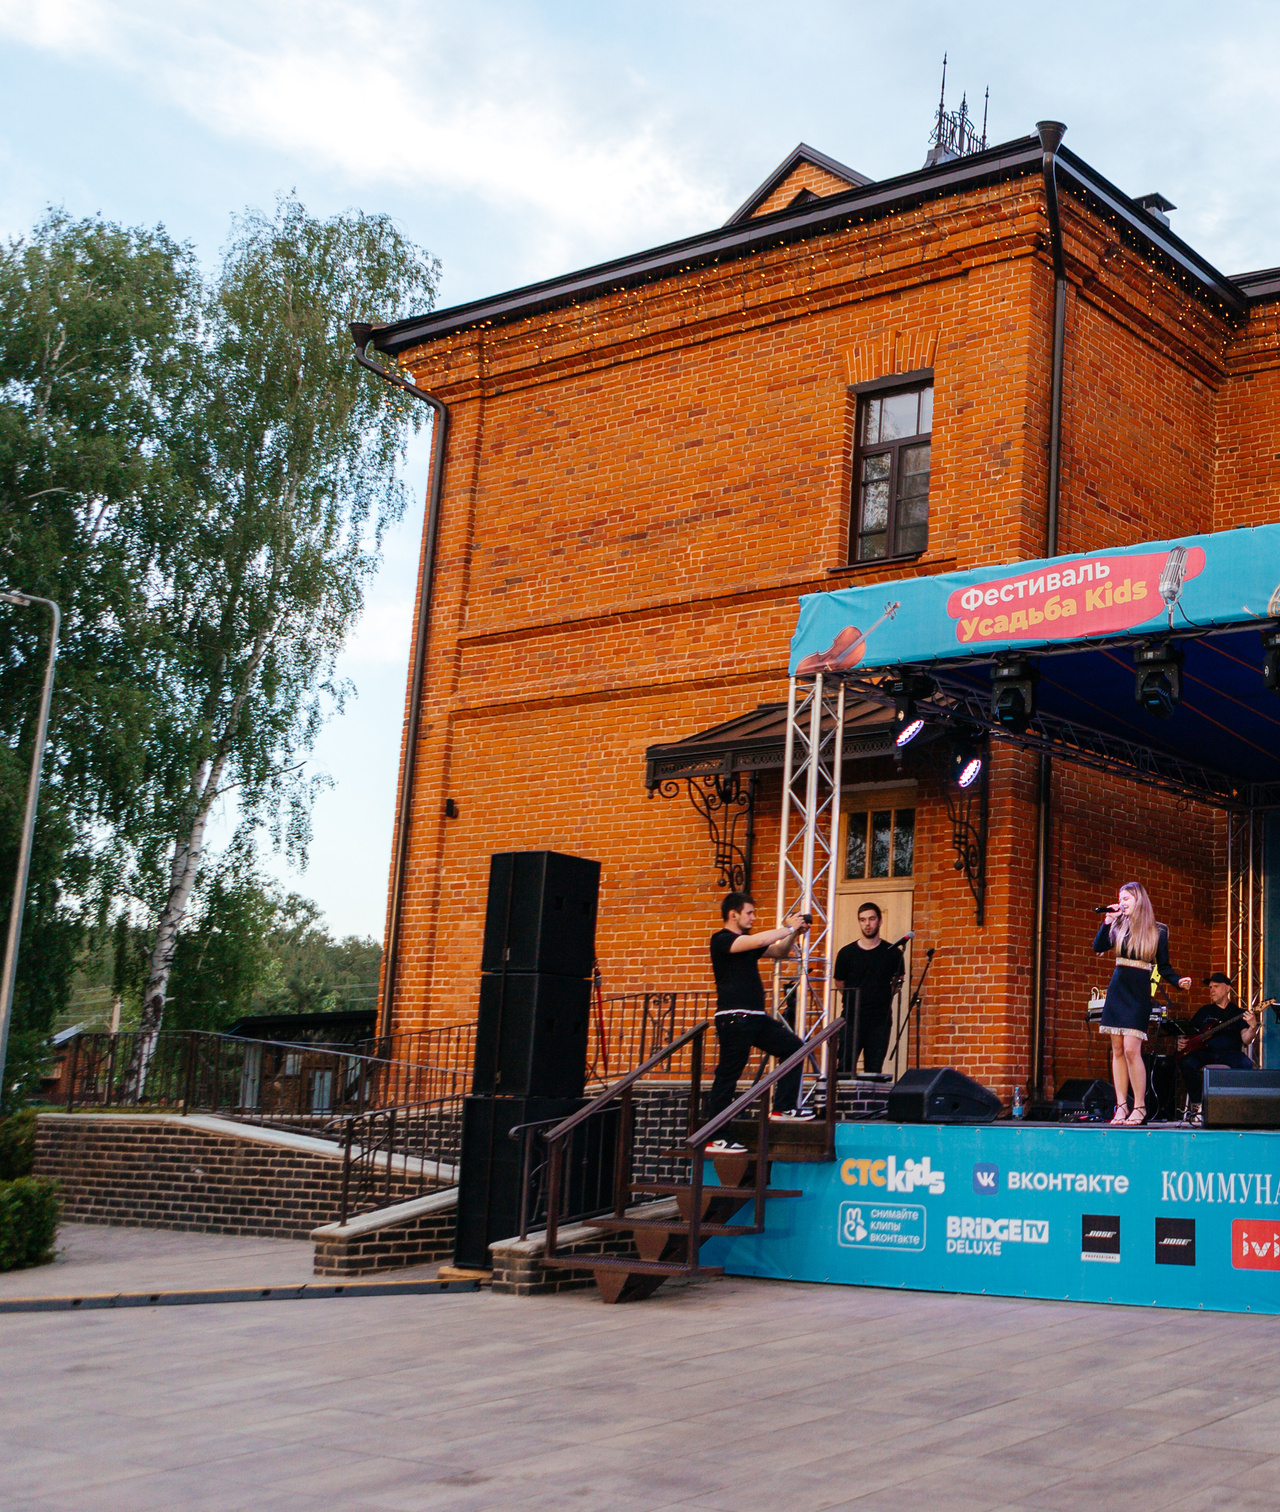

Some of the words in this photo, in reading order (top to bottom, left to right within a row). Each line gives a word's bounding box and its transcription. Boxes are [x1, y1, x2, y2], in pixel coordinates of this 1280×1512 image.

[960, 561, 1111, 612] Фестиваль
[961, 595, 1077, 642] Усадьба
[1085, 578, 1149, 612] Kids
[870, 1207, 920, 1221] снимайте
[870, 1220, 902, 1232] клипы
[946, 1240, 1002, 1257] DELUXE
